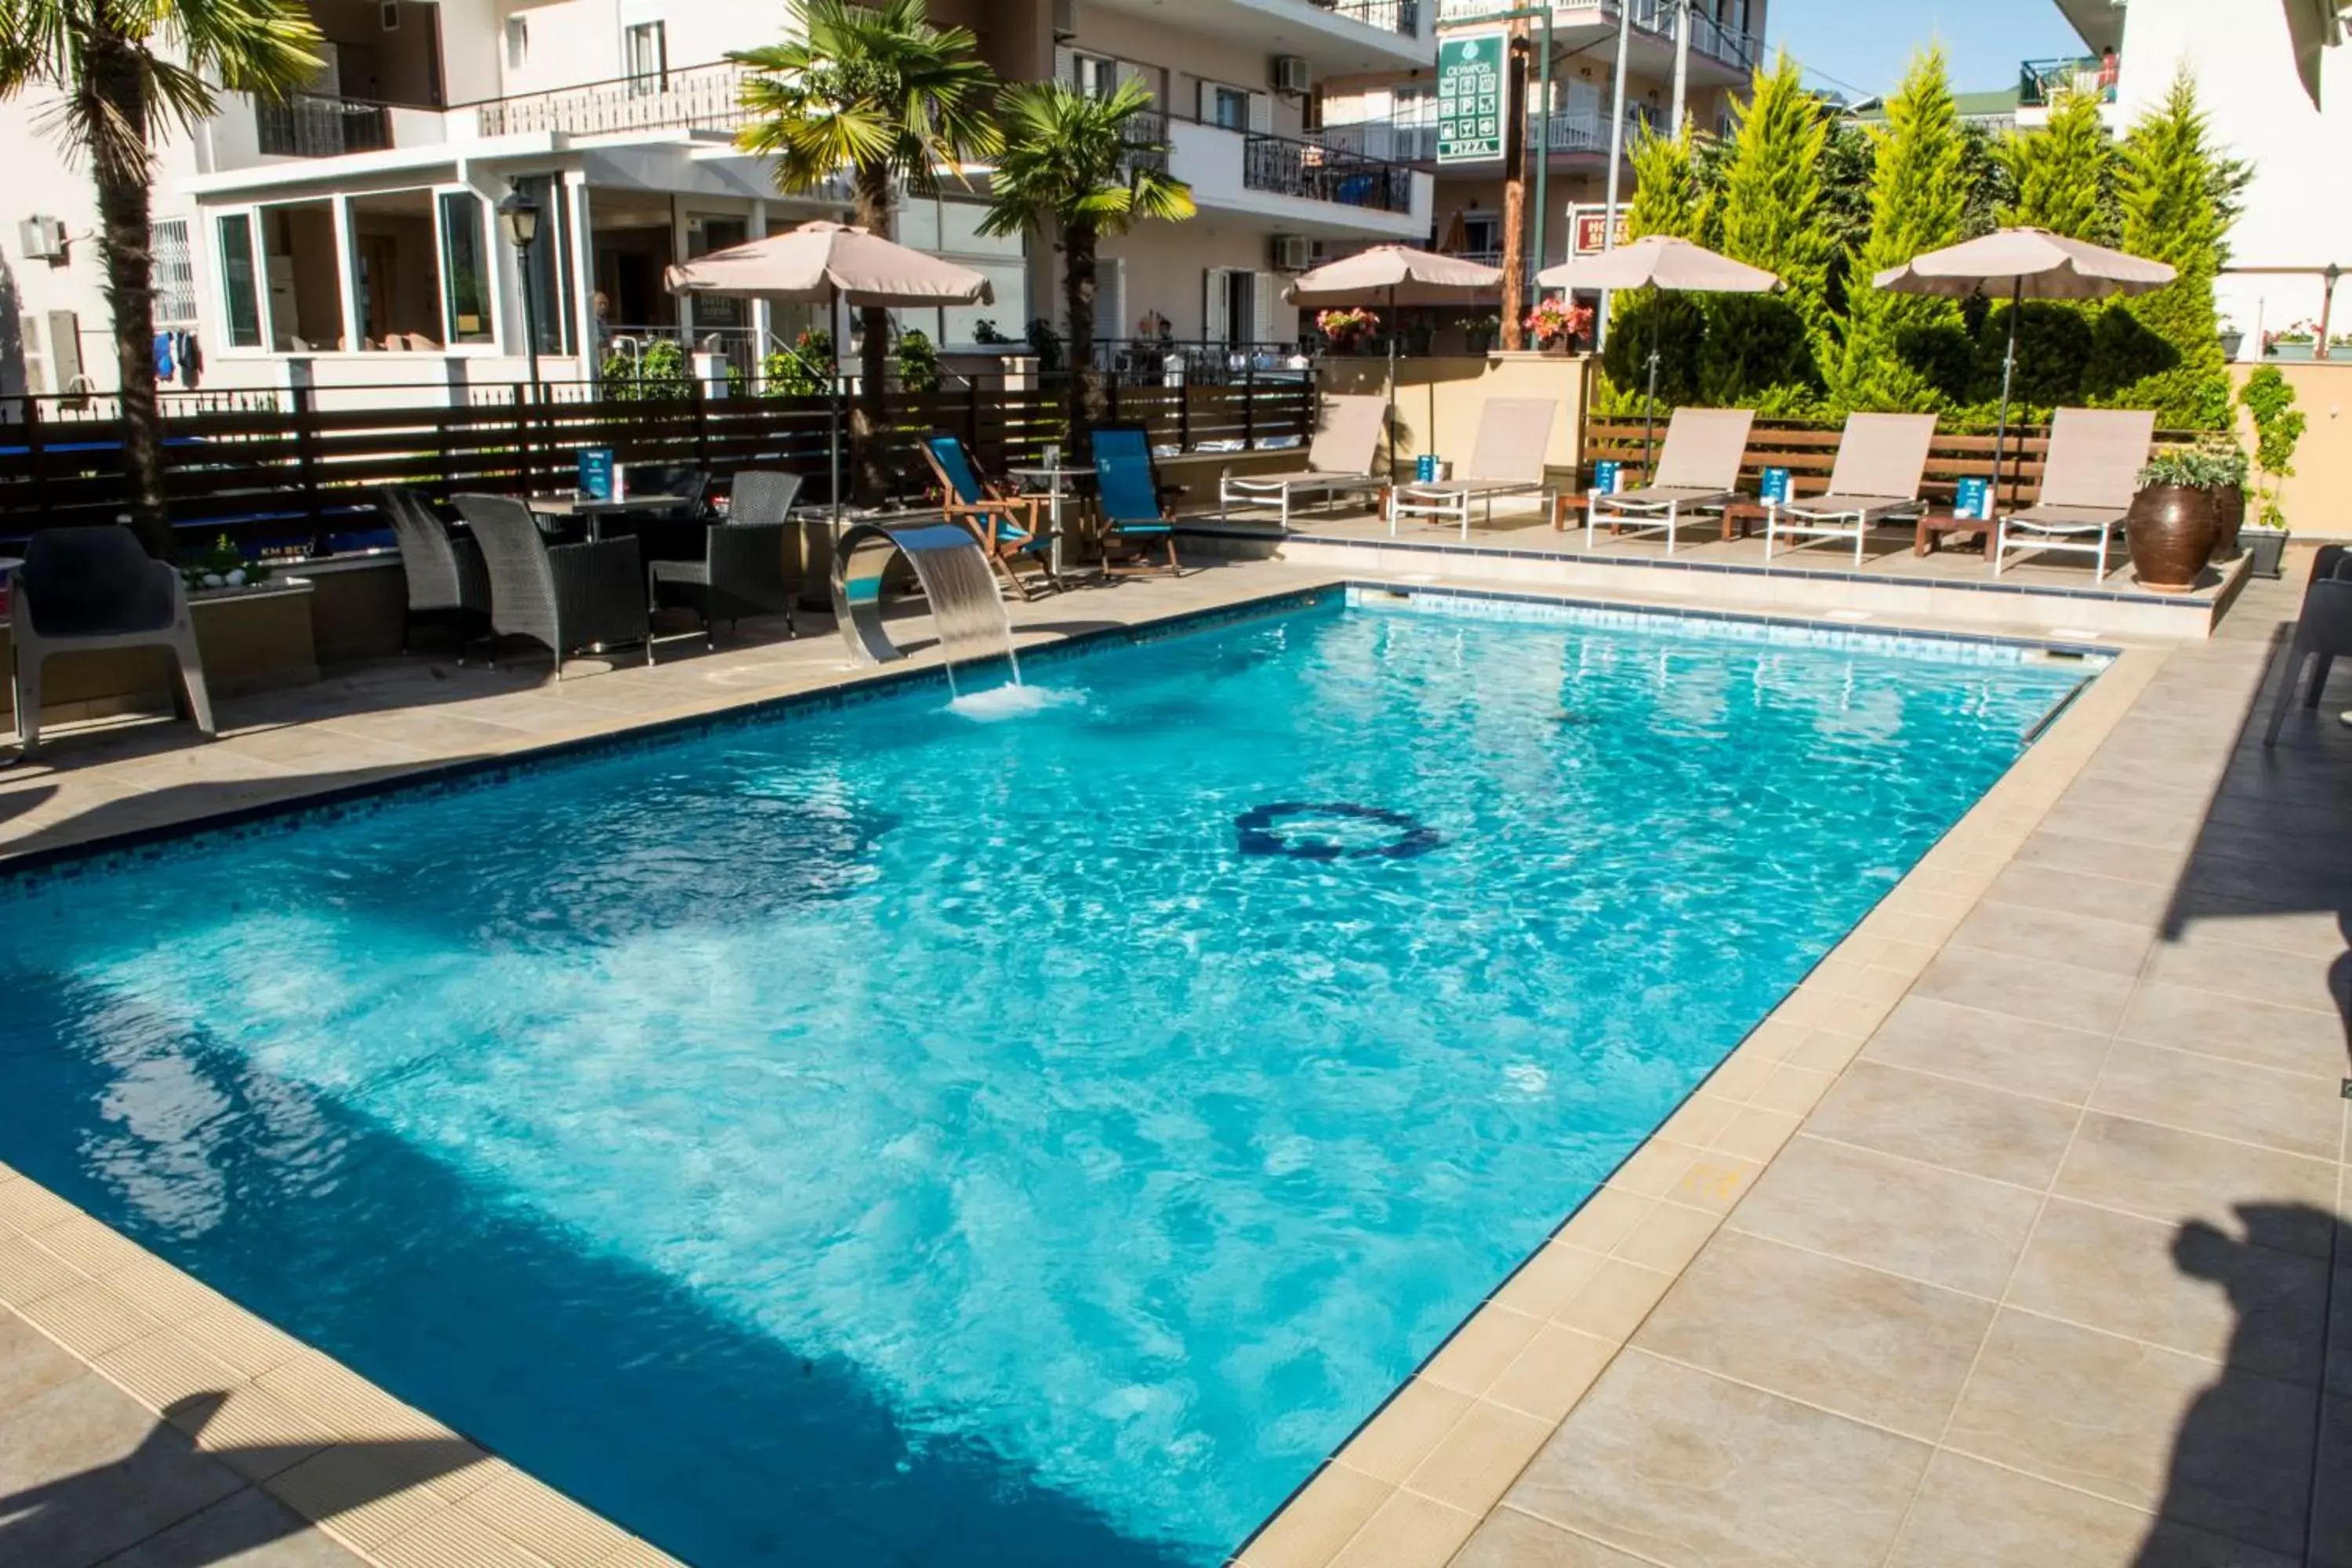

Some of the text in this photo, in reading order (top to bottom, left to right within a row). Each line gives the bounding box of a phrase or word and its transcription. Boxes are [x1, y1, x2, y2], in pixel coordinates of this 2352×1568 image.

[1446, 62, 1490, 77] OLYMPOS
[1452, 140, 1490, 155] PIZZA
[1588, 220, 1630, 233] HOEL
